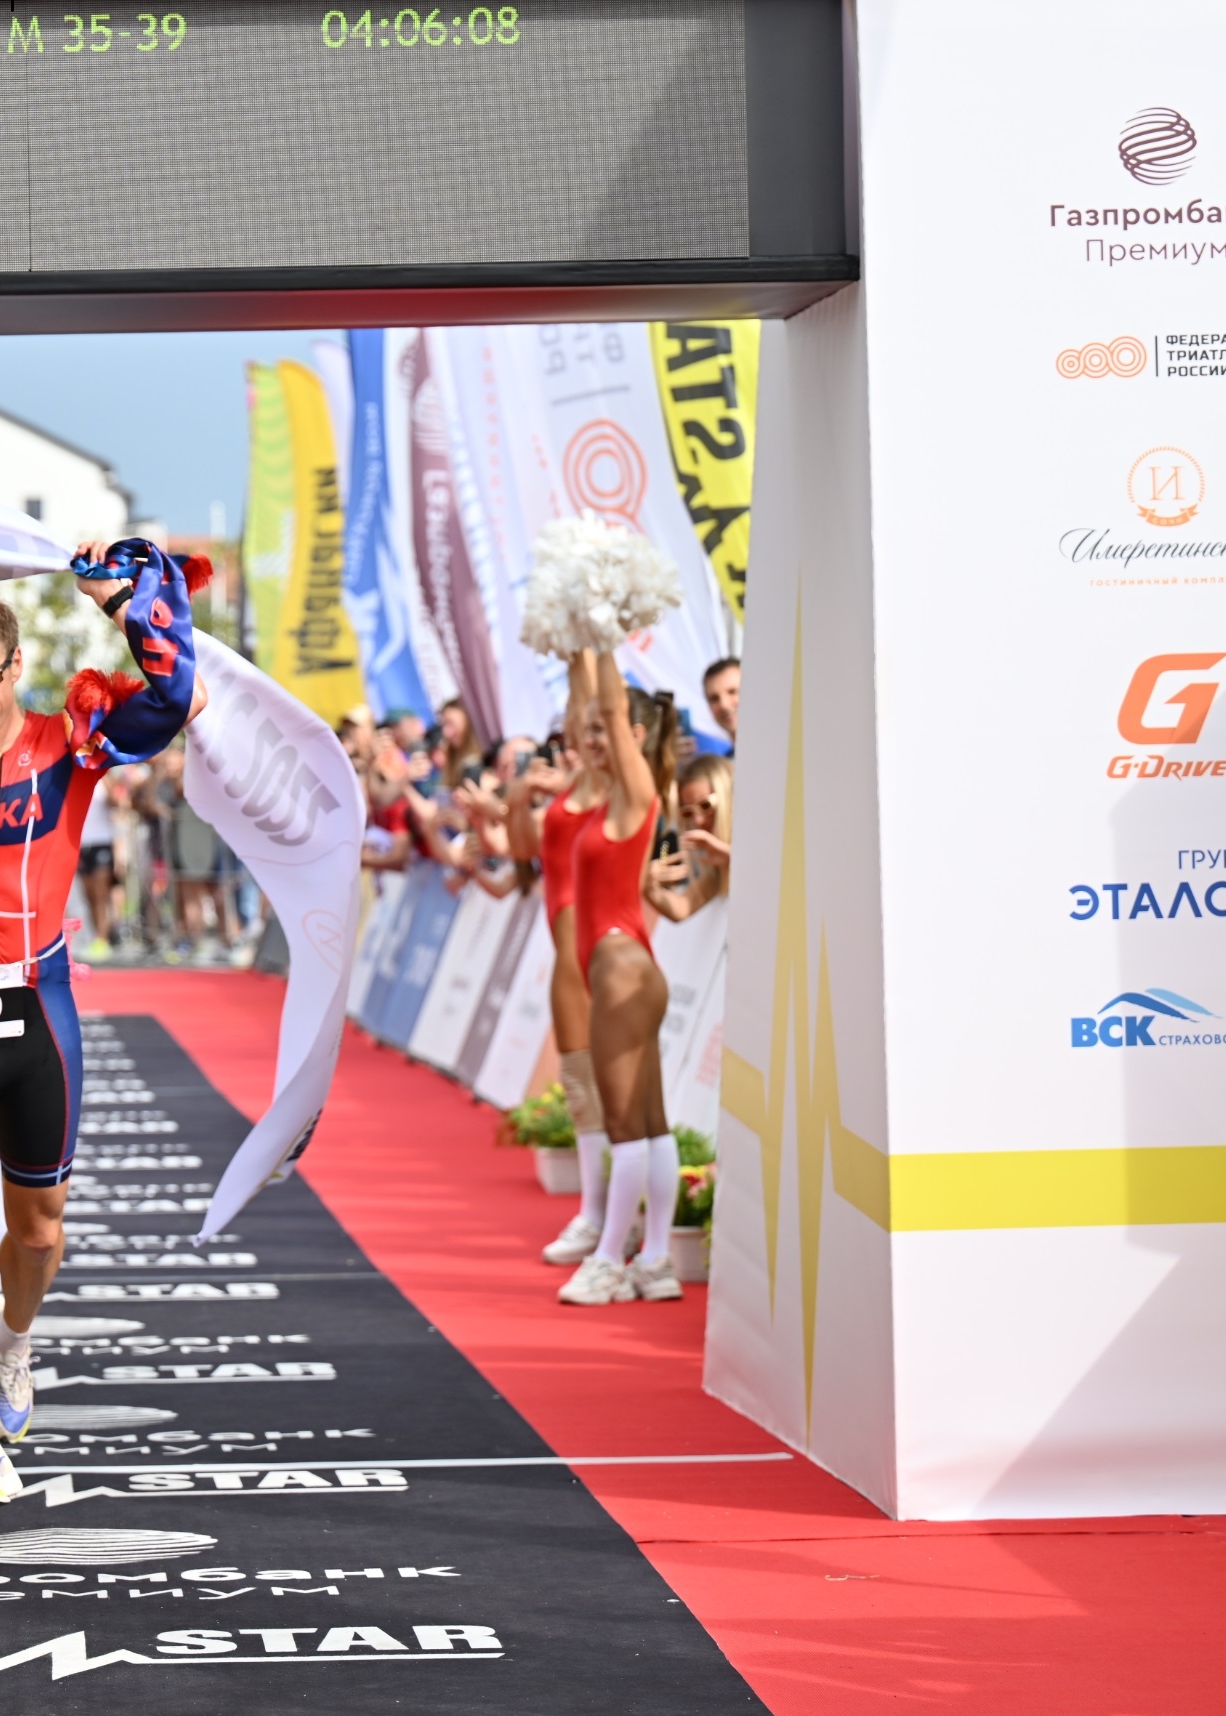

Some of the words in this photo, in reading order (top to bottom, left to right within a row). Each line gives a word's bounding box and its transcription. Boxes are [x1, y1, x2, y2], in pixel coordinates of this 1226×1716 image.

[63, 13, 187, 54] 35-39
[321, 6, 521, 48] 04:06:08
[1049, 198, 1226, 231] Газпромба
[1178, 849, 1226, 870] ГРУ
[1070, 1015, 1157, 1048] ВСК
[78, 1282, 280, 1298] STAR
[102, 1362, 338, 1380] STAR
[127, 1469, 409, 1490] STAR
[155, 1625, 506, 1656] STAR
